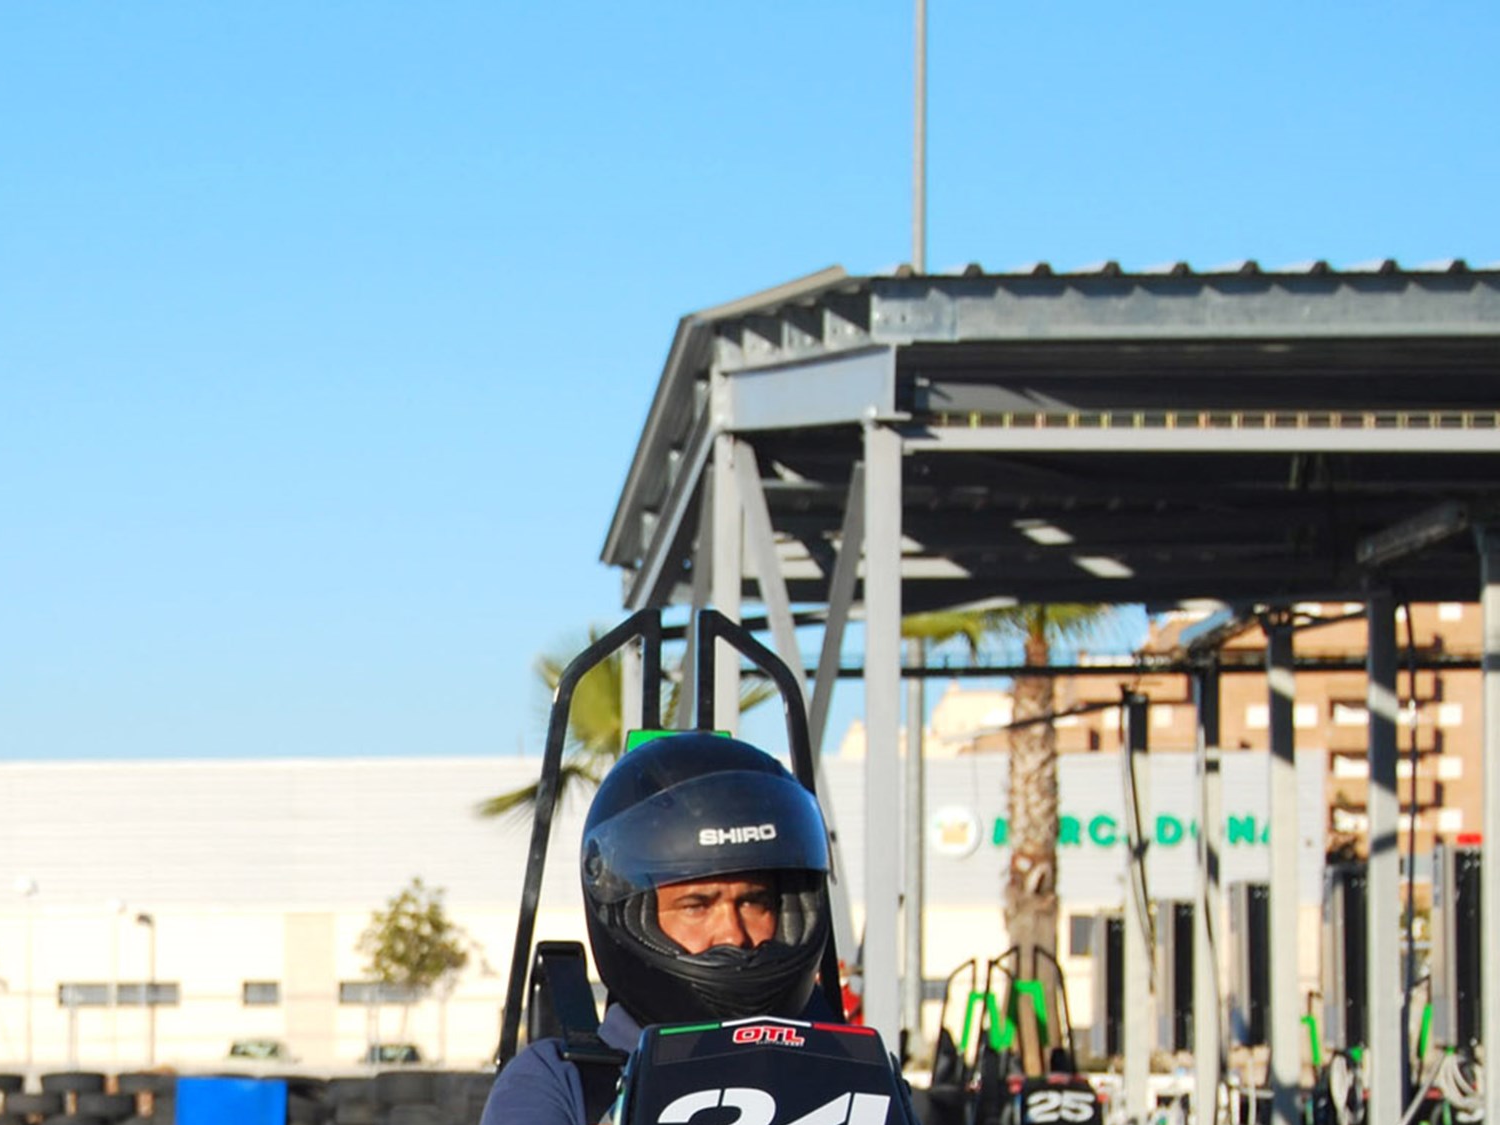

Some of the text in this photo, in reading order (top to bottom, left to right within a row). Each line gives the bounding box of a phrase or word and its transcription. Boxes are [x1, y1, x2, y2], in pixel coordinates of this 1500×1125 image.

[699, 823, 776, 846] SHIRO
[733, 1025, 805, 1044] OTL
[1026, 1090, 1096, 1123] 25
